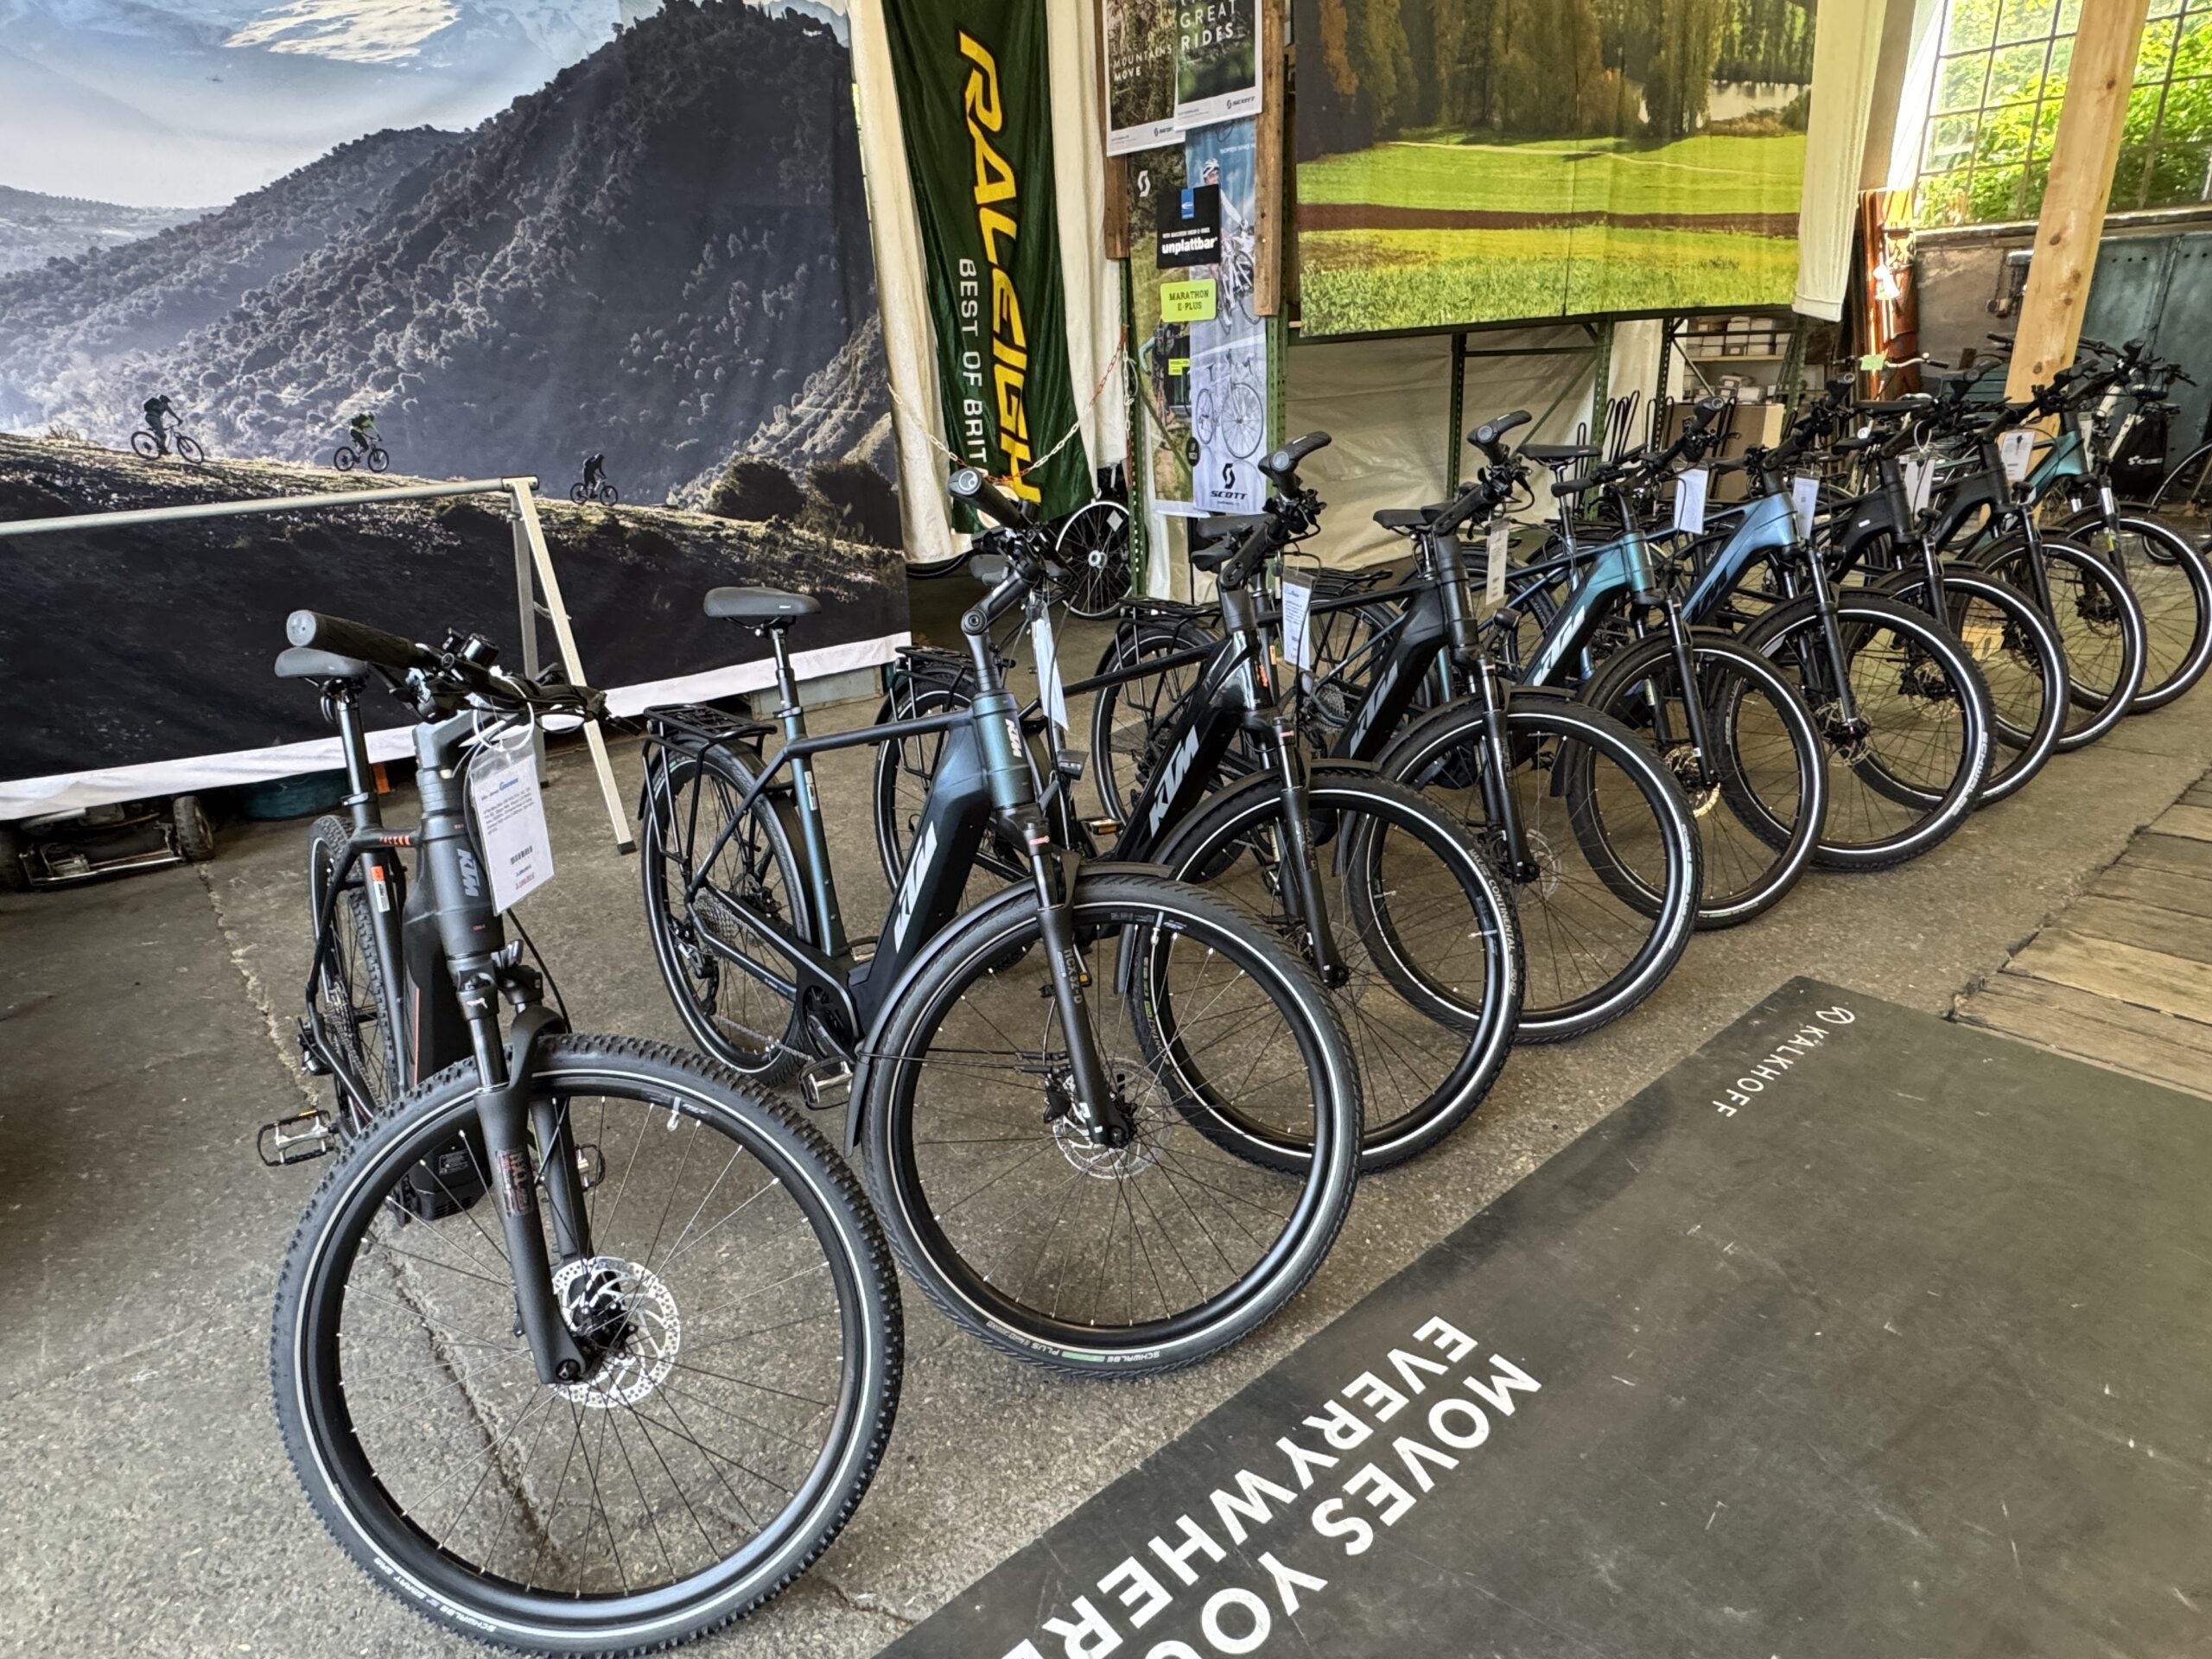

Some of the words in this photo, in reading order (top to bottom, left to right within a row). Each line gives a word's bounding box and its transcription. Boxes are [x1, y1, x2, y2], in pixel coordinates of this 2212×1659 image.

[1180, 0, 1236, 28] GREAT
[1181, 22, 1234, 52] RIDES
[1113, 43, 1173, 70] MOUNTAINS
[1114, 66, 1141, 82] MOVE
[959, 29, 1042, 505] RALEIGH
[959, 258, 979, 338] BEST
[1169, 289, 1209, 301] MARATHON
[963, 351, 982, 388] OF
[963, 398, 988, 478] BRIT
[1210, 490, 1248, 500] SCOTT
[1533, 605, 1585, 687] KTM
[1006, 718, 1023, 759] KTM
[1350, 659, 1398, 759] KTM
[1149, 724, 1199, 838] KTM
[457, 848, 480, 897] KTM
[893, 820, 938, 954] KTM
[1488, 879, 1516, 952] CONTINENTAL
[1712, 1024, 1830, 1117] KALKHOFF
[1031, 1341, 1061, 1356] PLUS
[1106, 1350, 1160, 1363] SCHWALBE
[1001, 1315, 1478, 1659] EVERYWHER
[1312, 1353, 1542, 1556] MOVES
[1144, 1552, 1328, 1659] YO
